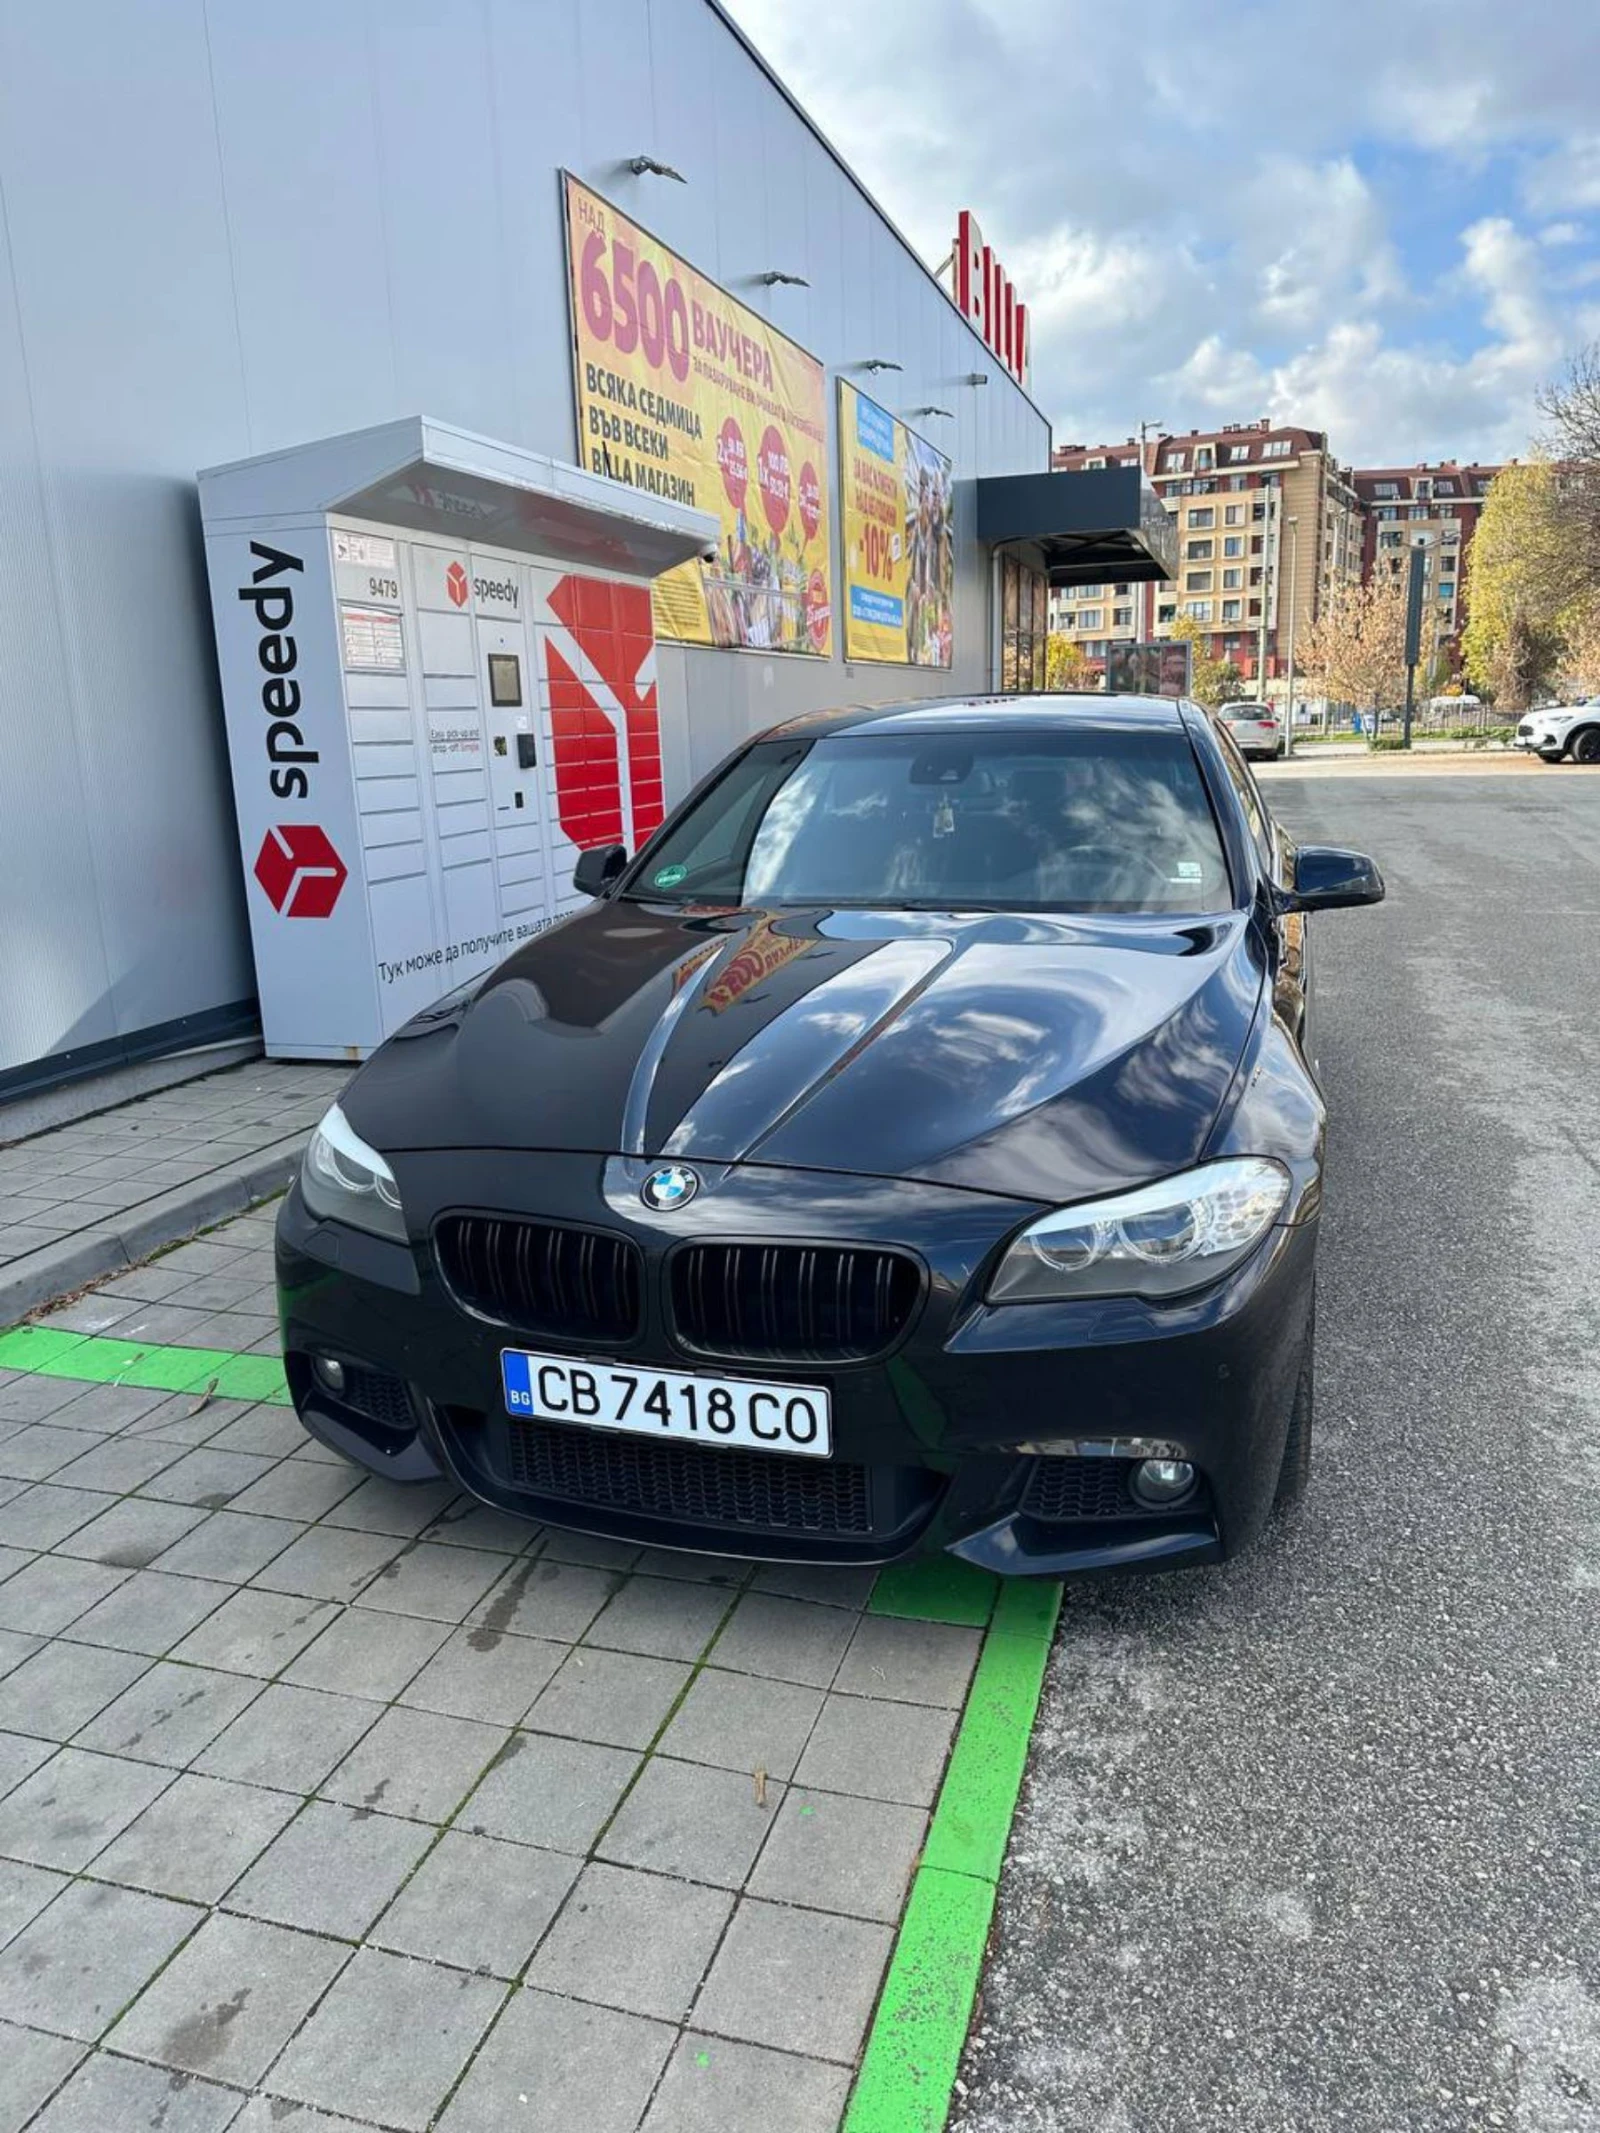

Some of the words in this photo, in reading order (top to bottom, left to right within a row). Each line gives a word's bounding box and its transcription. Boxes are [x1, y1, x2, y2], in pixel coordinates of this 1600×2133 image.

[577, 196, 606, 239] НАД
[580, 229, 690, 383] 6500
[691, 299, 774, 393] ВАУЧЕРА
[586, 362, 637, 410] ВСЯКА
[638, 387, 702, 440] СЕДМИЦА
[589, 405, 622, 442] ВЪВ
[624, 419, 669, 461] ВСЕКИ
[635, 461, 696, 507] МАГАЗИН
[859, 522, 893, 582] -10%
[369, 577, 399, 599] 9479
[473, 577, 519, 609] speedy
[238, 540, 319, 799] speedy
[378, 961, 404, 984] Тук
[405, 949, 443, 973] може
[445, 944, 460, 963] да
[461, 928, 514, 956] получите
[516, 917, 552, 939] вашата
[510, 1389, 532, 1407] BG
[538, 1365, 600, 1417] CB
[610, 1374, 737, 1435] 7418
[749, 1391, 818, 1445] CO
